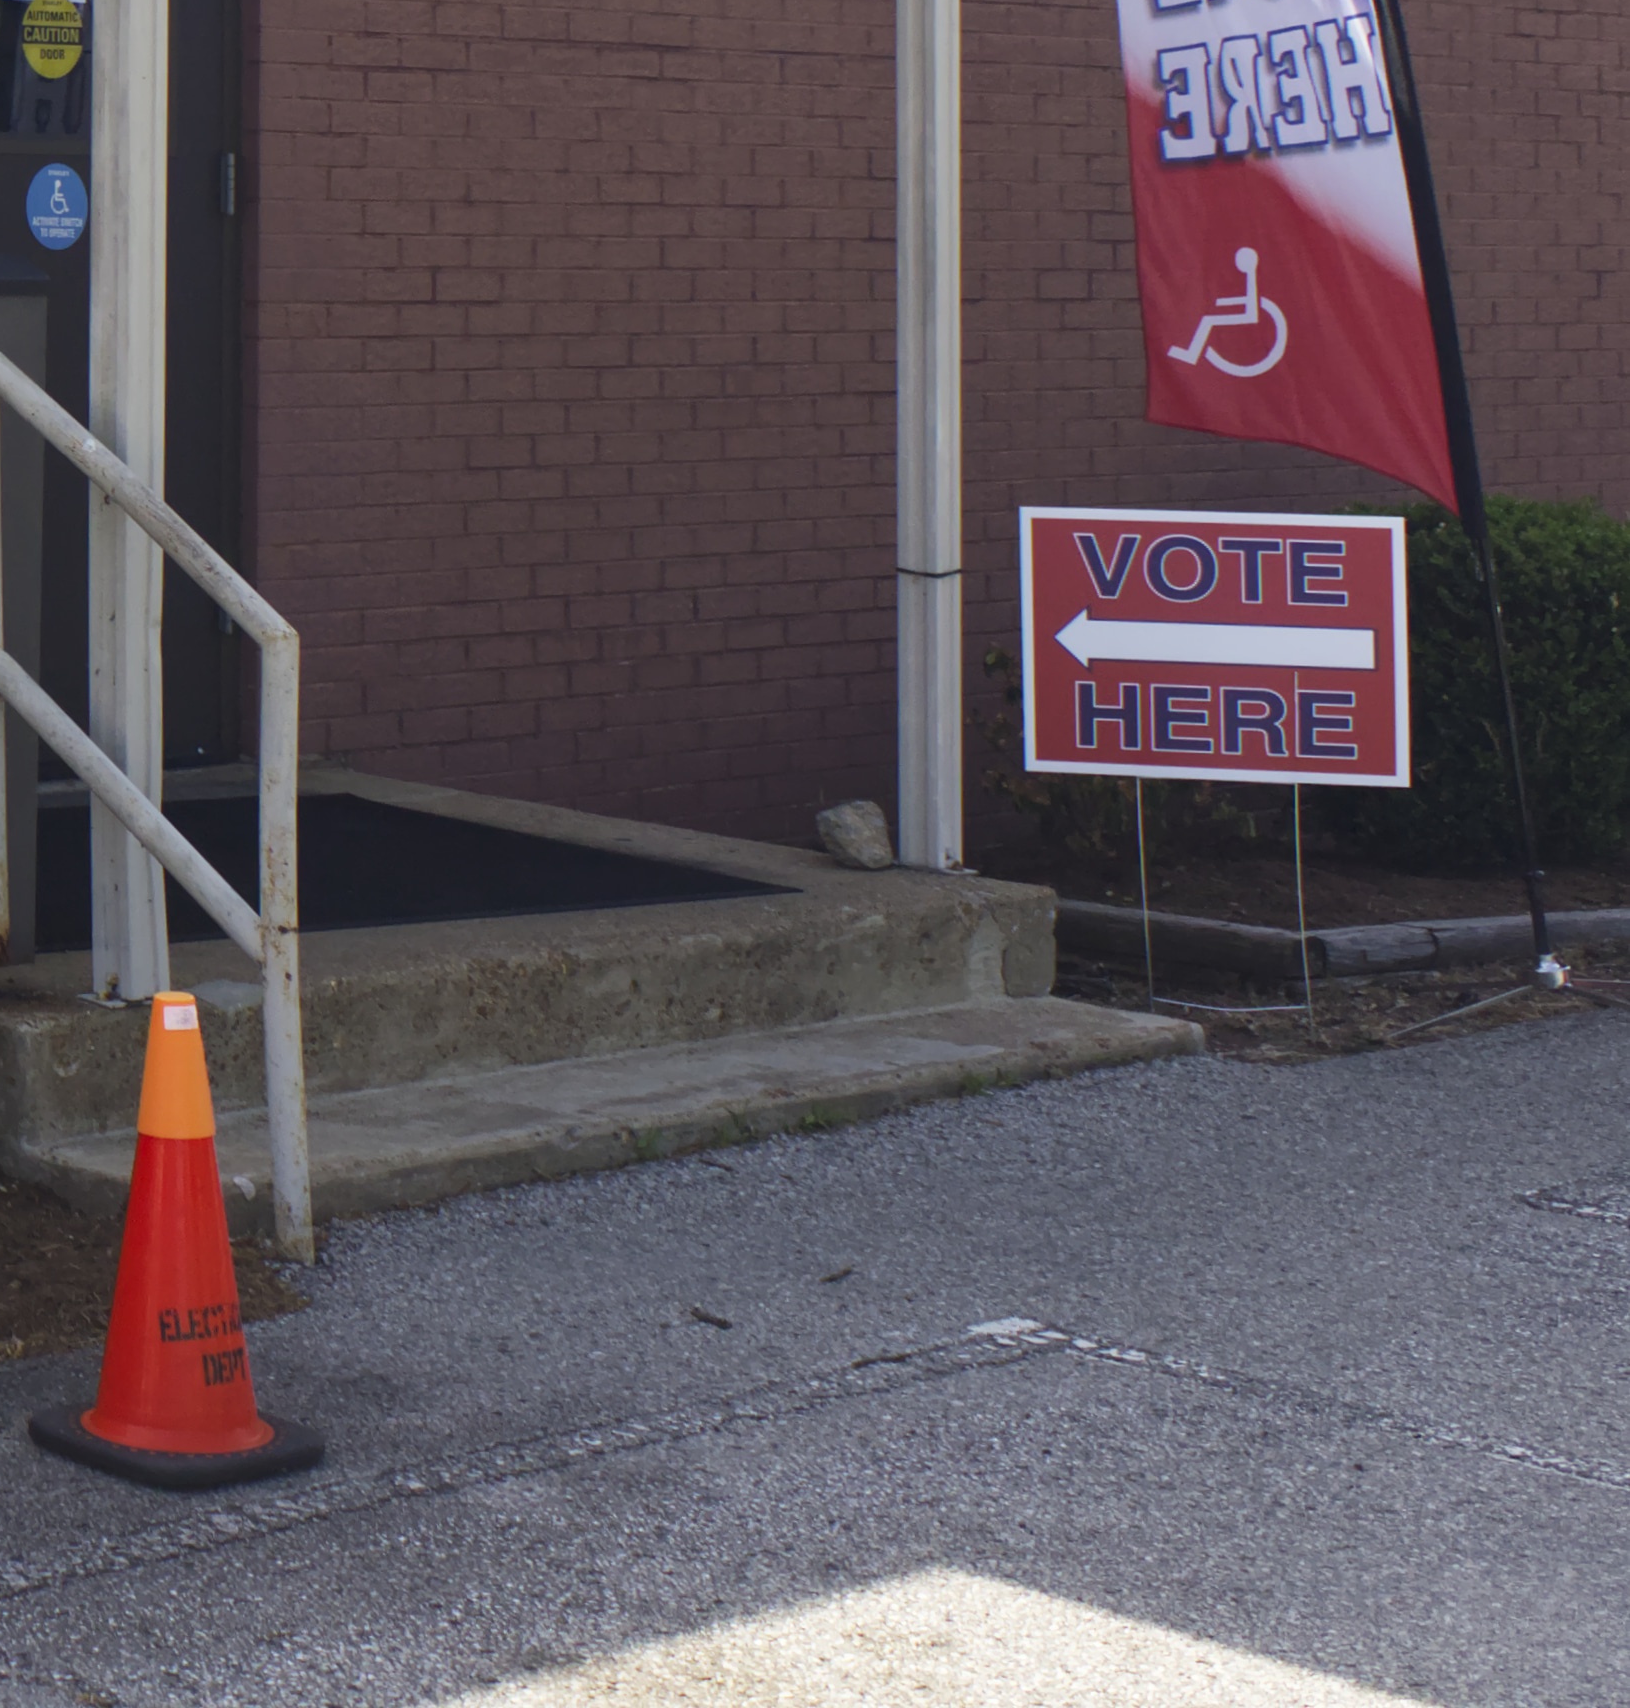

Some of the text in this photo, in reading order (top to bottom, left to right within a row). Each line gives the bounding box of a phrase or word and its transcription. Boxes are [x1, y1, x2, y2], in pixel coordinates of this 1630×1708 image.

[27, 10, 78, 23] AUTOMATIC
[23, 26, 80, 43] CAUTION
[40, 48, 65, 60] DOOR
[1072, 532, 1349, 608] VOTE
[1074, 680, 1359, 761] HERE
